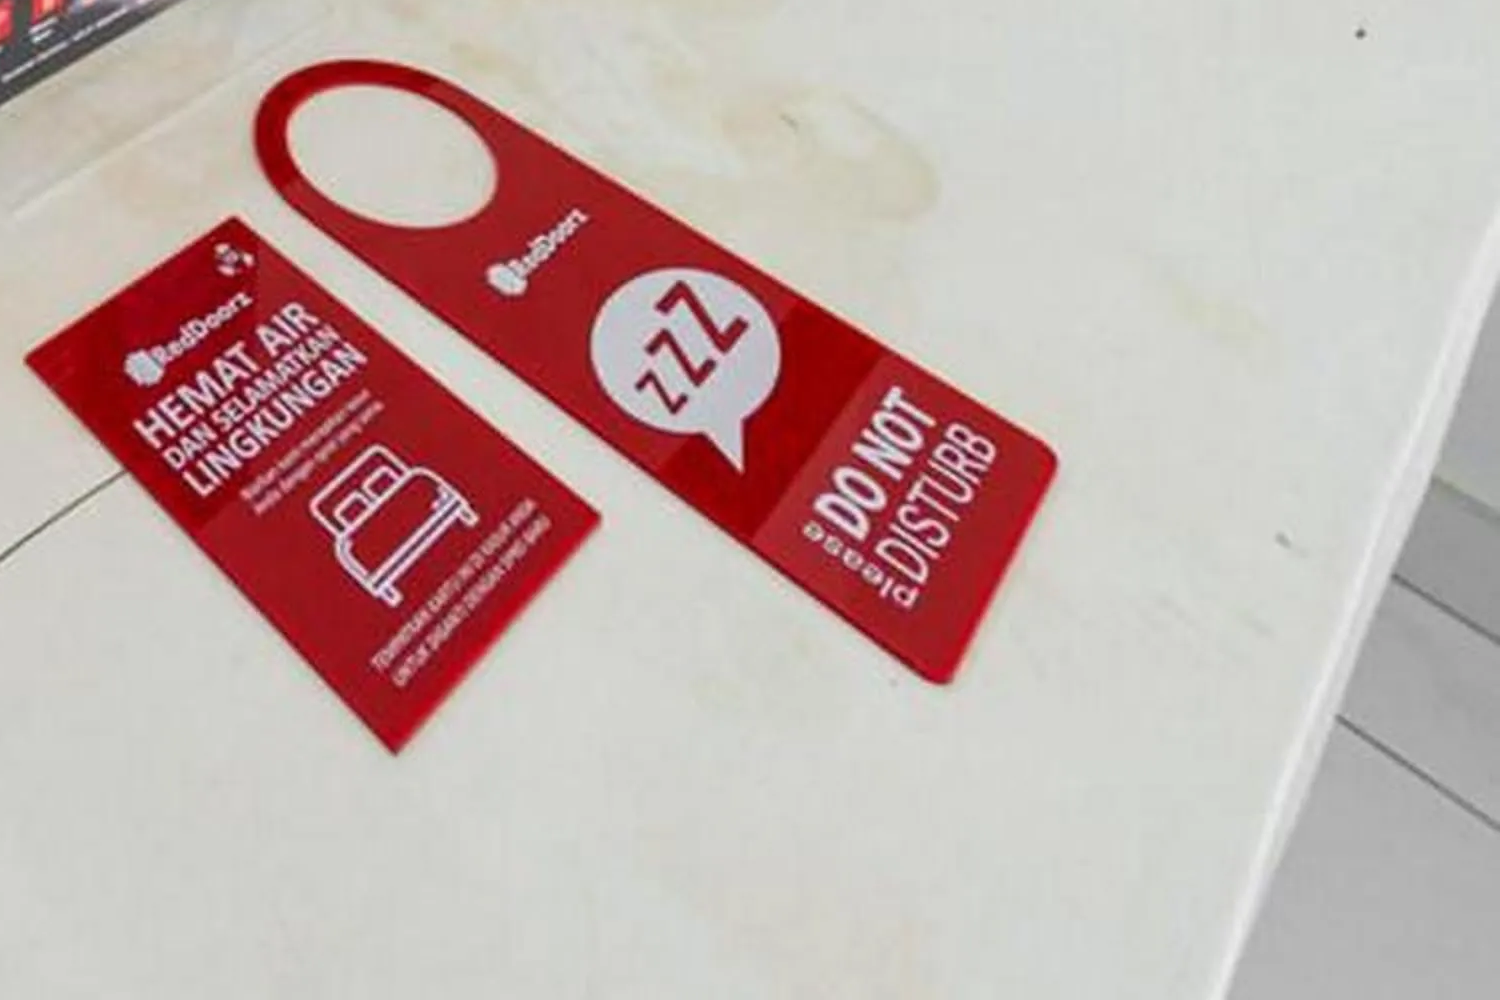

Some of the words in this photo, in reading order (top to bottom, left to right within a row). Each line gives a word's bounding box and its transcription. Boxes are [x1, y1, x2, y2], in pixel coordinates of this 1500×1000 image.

[133, 340, 261, 449] HEMAT
[255, 301, 320, 357] AIR
[162, 421, 218, 470] DAN
[211, 322, 342, 433] SELAMATKAN
[182, 342, 368, 497] LINGKUNGAN
[812, 466, 888, 543] DO
[851, 384, 937, 483] NOT
[873, 421, 998, 586] DISTURB
